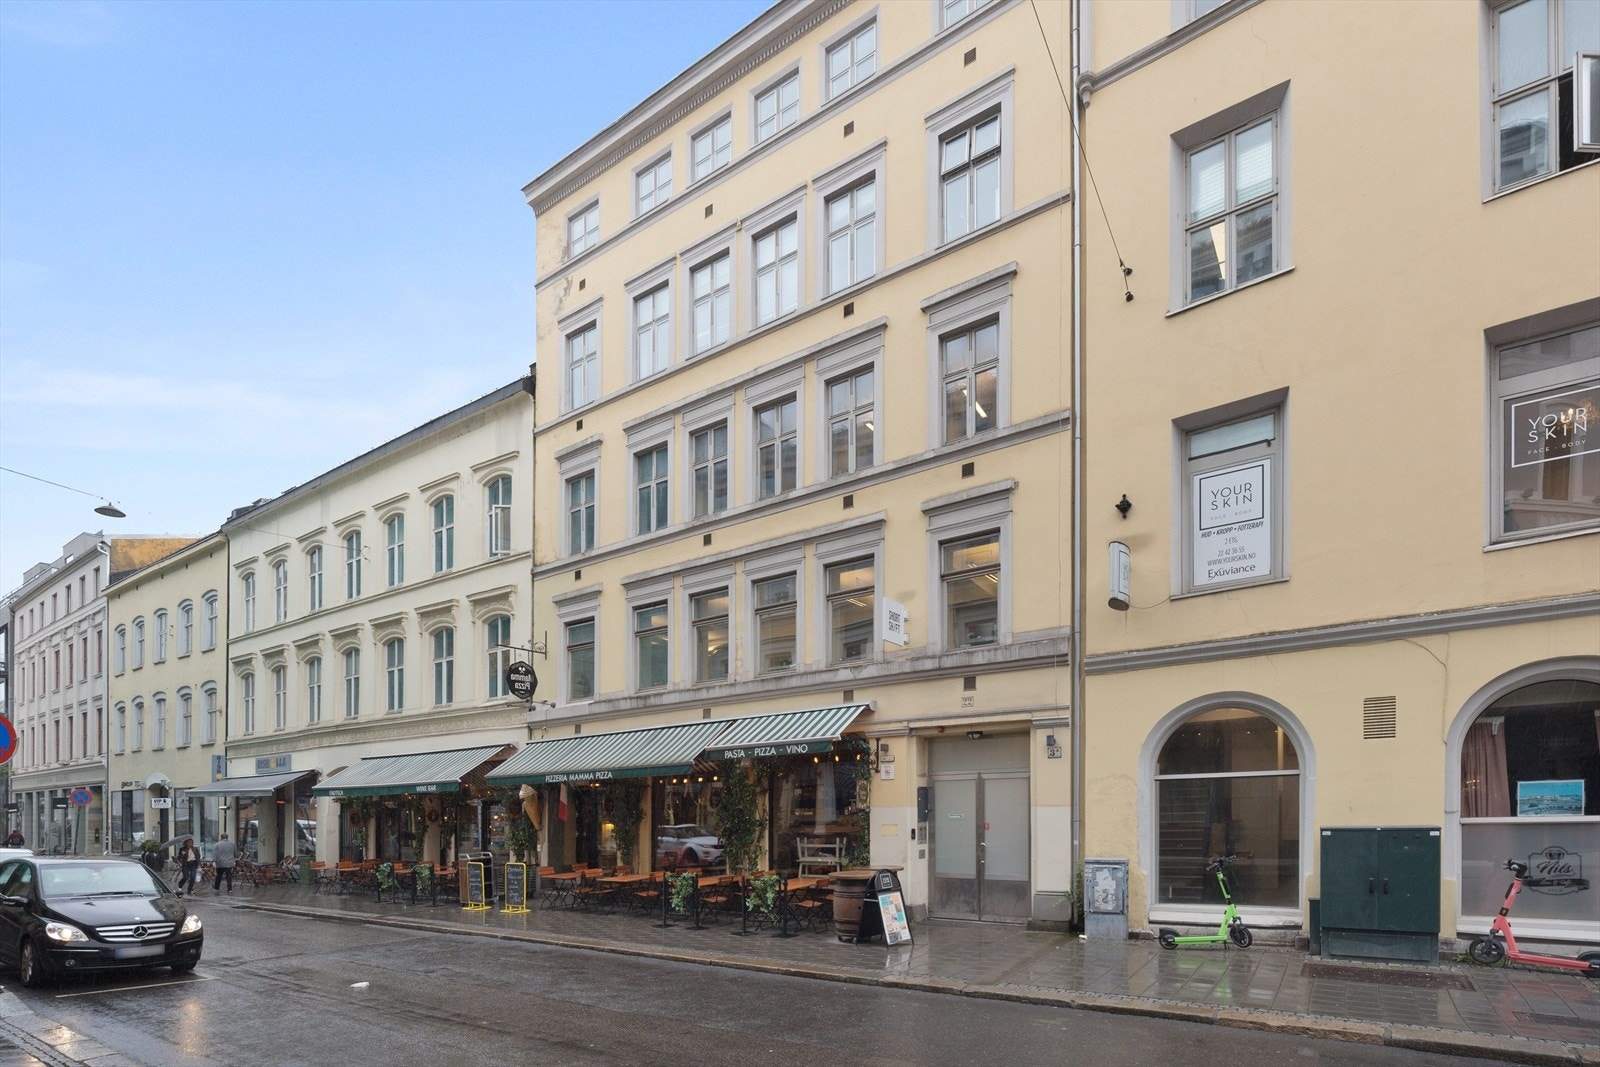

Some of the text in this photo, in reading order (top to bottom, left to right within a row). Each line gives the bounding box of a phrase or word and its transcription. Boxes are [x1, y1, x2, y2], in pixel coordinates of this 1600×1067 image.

[1528, 407, 1587, 430] YOUR
[1528, 420, 1587, 443] SKIN
[1527, 439, 1586, 455] FACE BODY
[1210, 482, 1252, 500] YOUR
[1210, 493, 1253, 511] SKIN
[1216, 527, 1233, 535] KROPP
[1207, 552, 1256, 566] WWW.YOURSKIN.NO
[1208, 564, 1256, 580] Exuviance
[724, 743, 809, 759] PASTA PIZZA VINO
[545, 770, 613, 783] PIZZERIA MAMMA PIZZA
[415, 785, 428, 793] WINE
[428, 784, 437, 792] BAR
[1536, 860, 1574, 876] Nils
